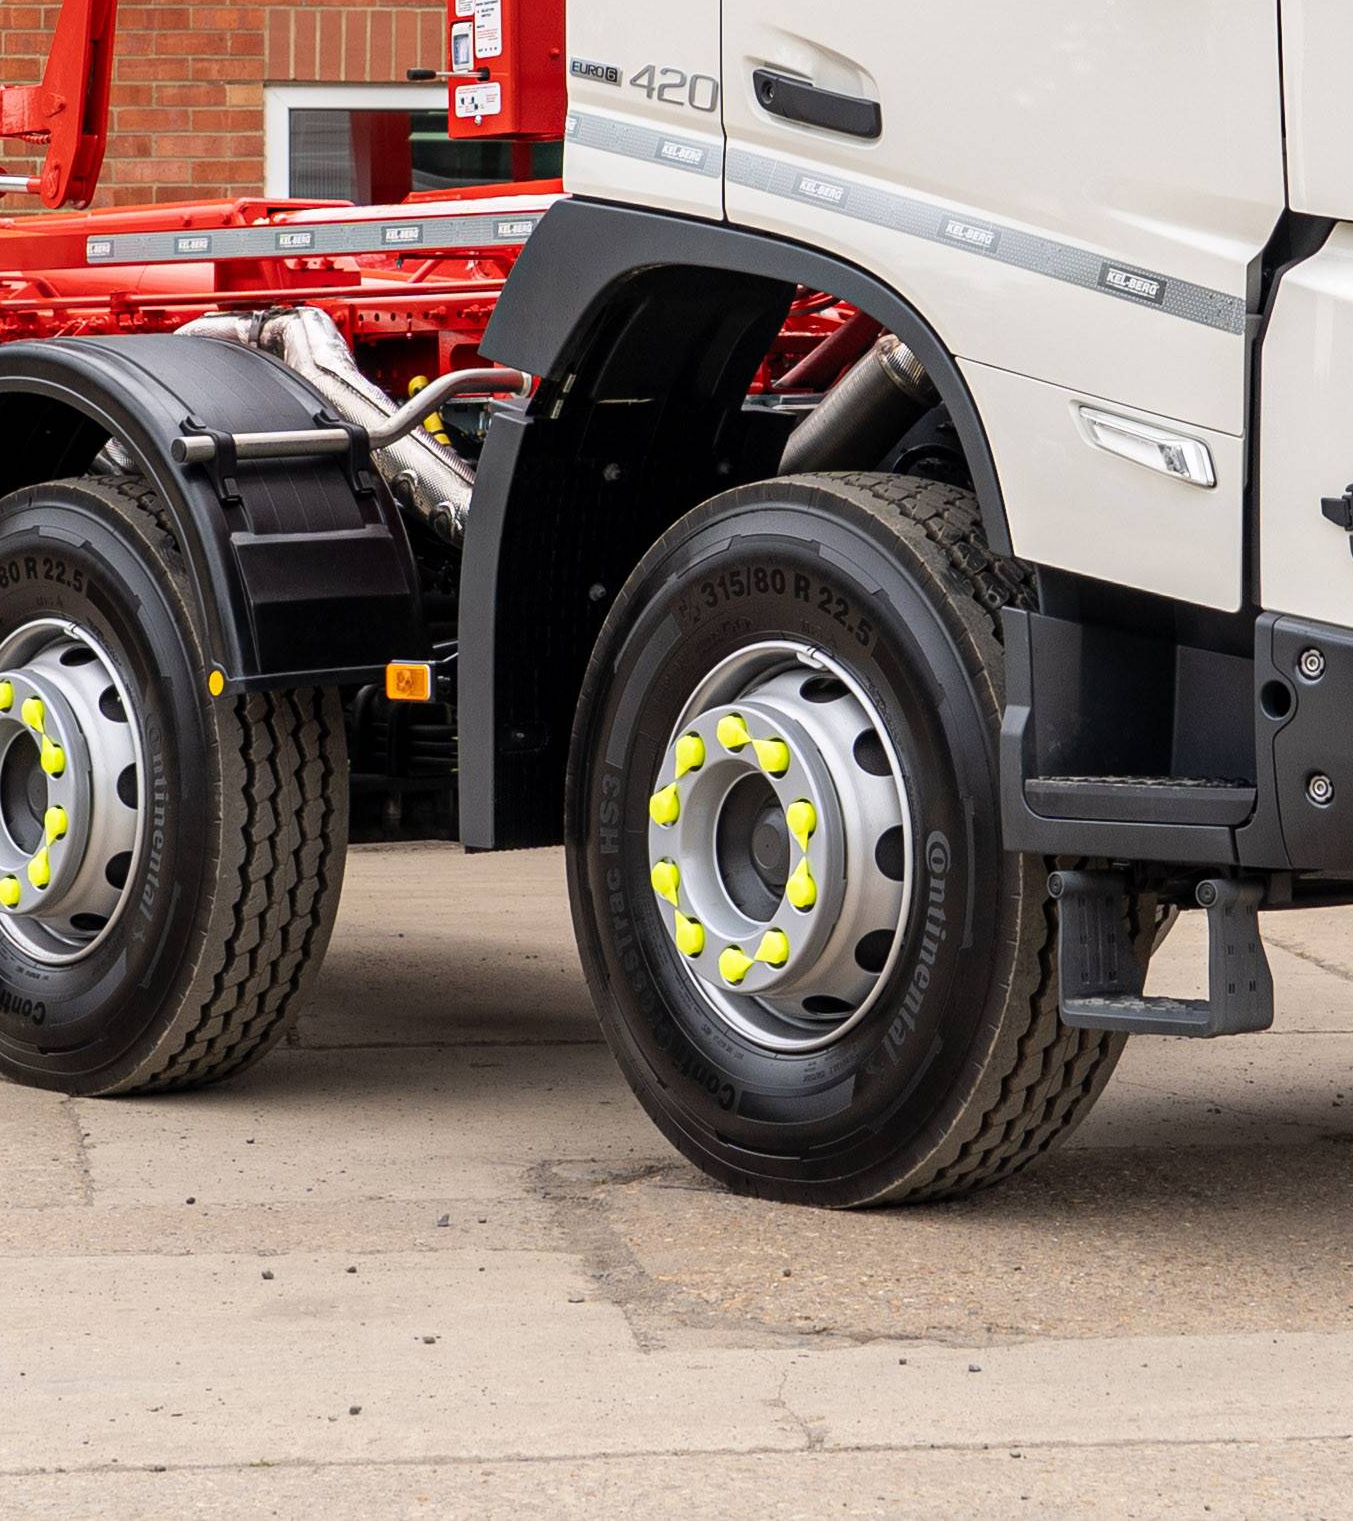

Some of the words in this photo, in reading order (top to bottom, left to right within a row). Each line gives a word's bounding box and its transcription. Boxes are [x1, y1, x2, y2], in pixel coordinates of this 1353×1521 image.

[629, 64, 719, 113] 420
[662, 143, 704, 162] KEL-BERG
[799, 179, 844, 200] KEL-BERG
[945, 223, 994, 245] KEL-BERG
[1106, 270, 1159, 295] KEL-BERG
[24, 556, 39, 580] R
[43, 557, 83, 593] 22.5
[700, 567, 786, 608] 315/80
[794, 573, 811, 602] R
[817, 586, 873, 646] 22.5
[138, 713, 169, 922] Continental
[599, 774, 621, 854] HS3
[881, 830, 951, 1065] Continental
